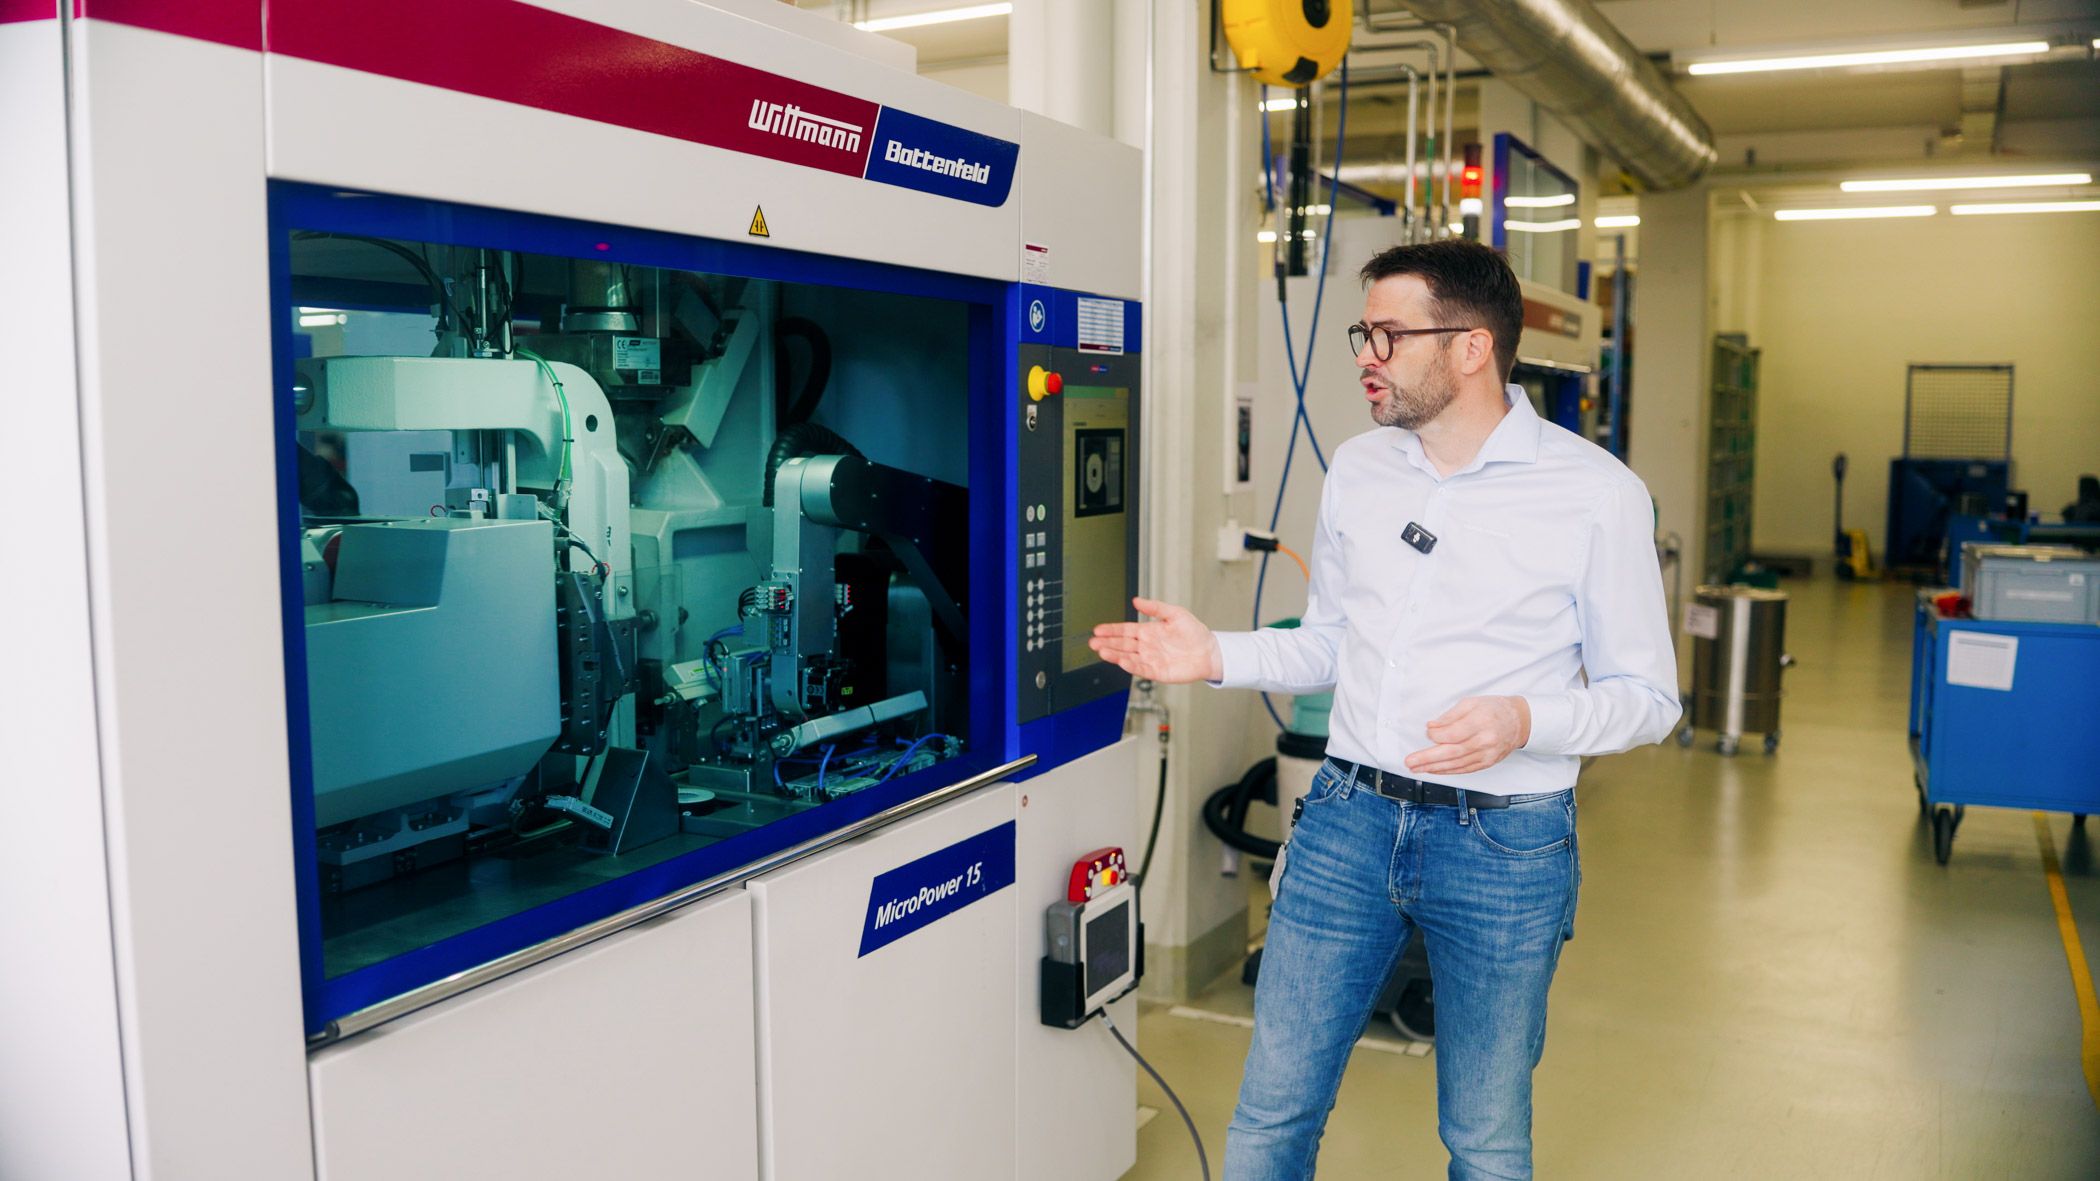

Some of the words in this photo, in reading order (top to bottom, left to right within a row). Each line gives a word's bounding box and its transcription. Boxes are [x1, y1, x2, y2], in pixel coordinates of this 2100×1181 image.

[748, 98, 863, 154] Wittmann
[884, 139, 991, 185] Battenfeld
[874, 875, 963, 930] MicroPower
[966, 861, 983, 888] 15
